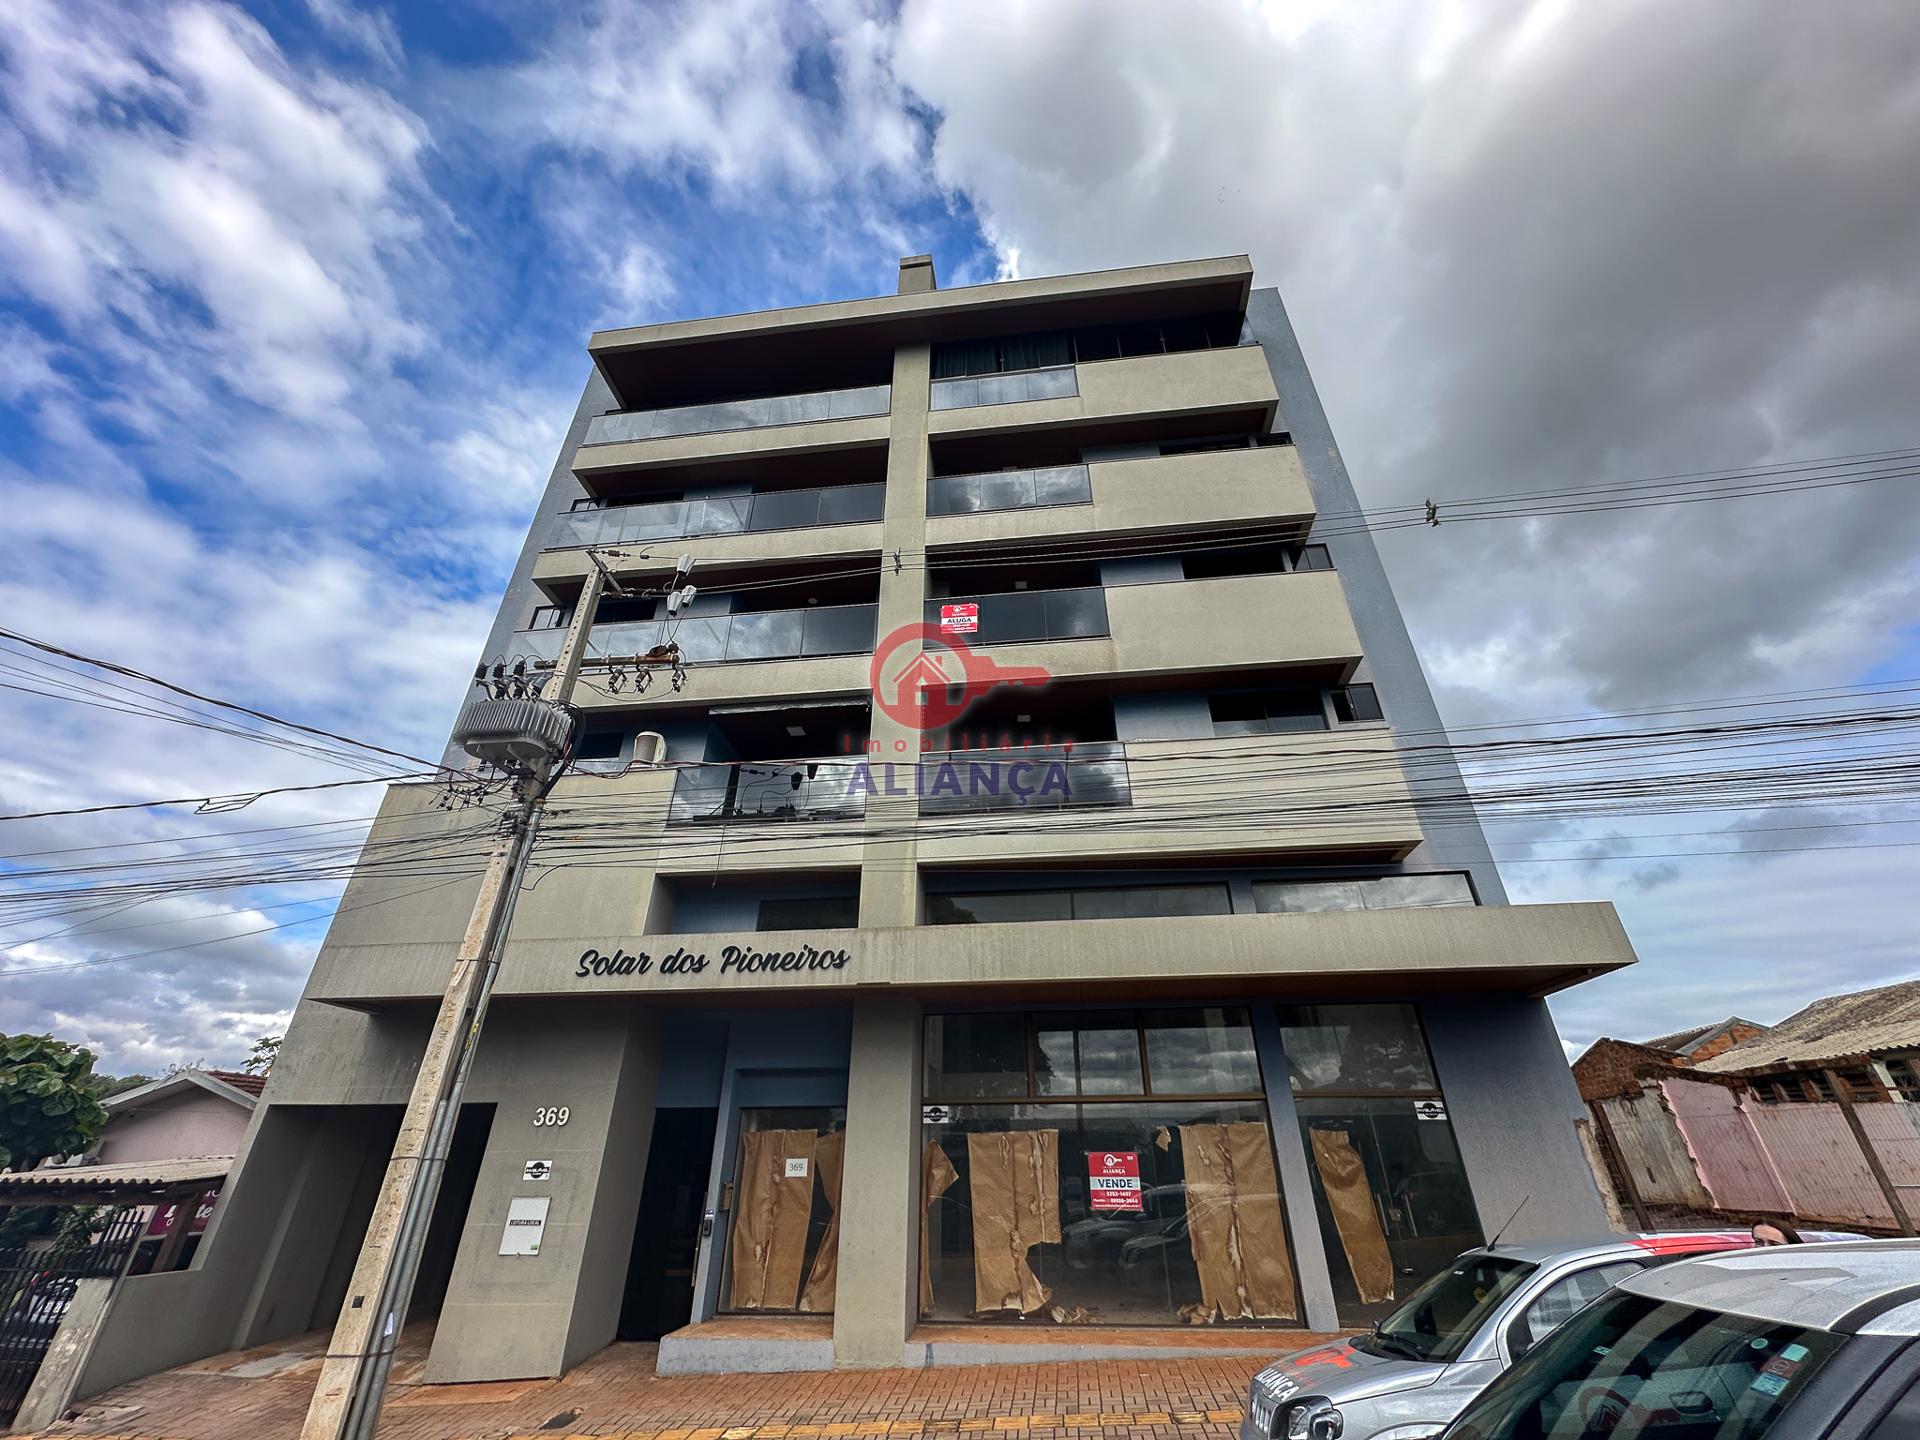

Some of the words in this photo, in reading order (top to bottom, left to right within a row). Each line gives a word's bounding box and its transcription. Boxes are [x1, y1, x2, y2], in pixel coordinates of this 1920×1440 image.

[575, 948, 653, 977] Solar
[659, 947, 709, 974] dos
[720, 944, 850, 974] Pioneiros
[533, 1106, 570, 1127] 369
[789, 1163, 802, 1171] 369
[1098, 1179, 1133, 1188] VENDE
